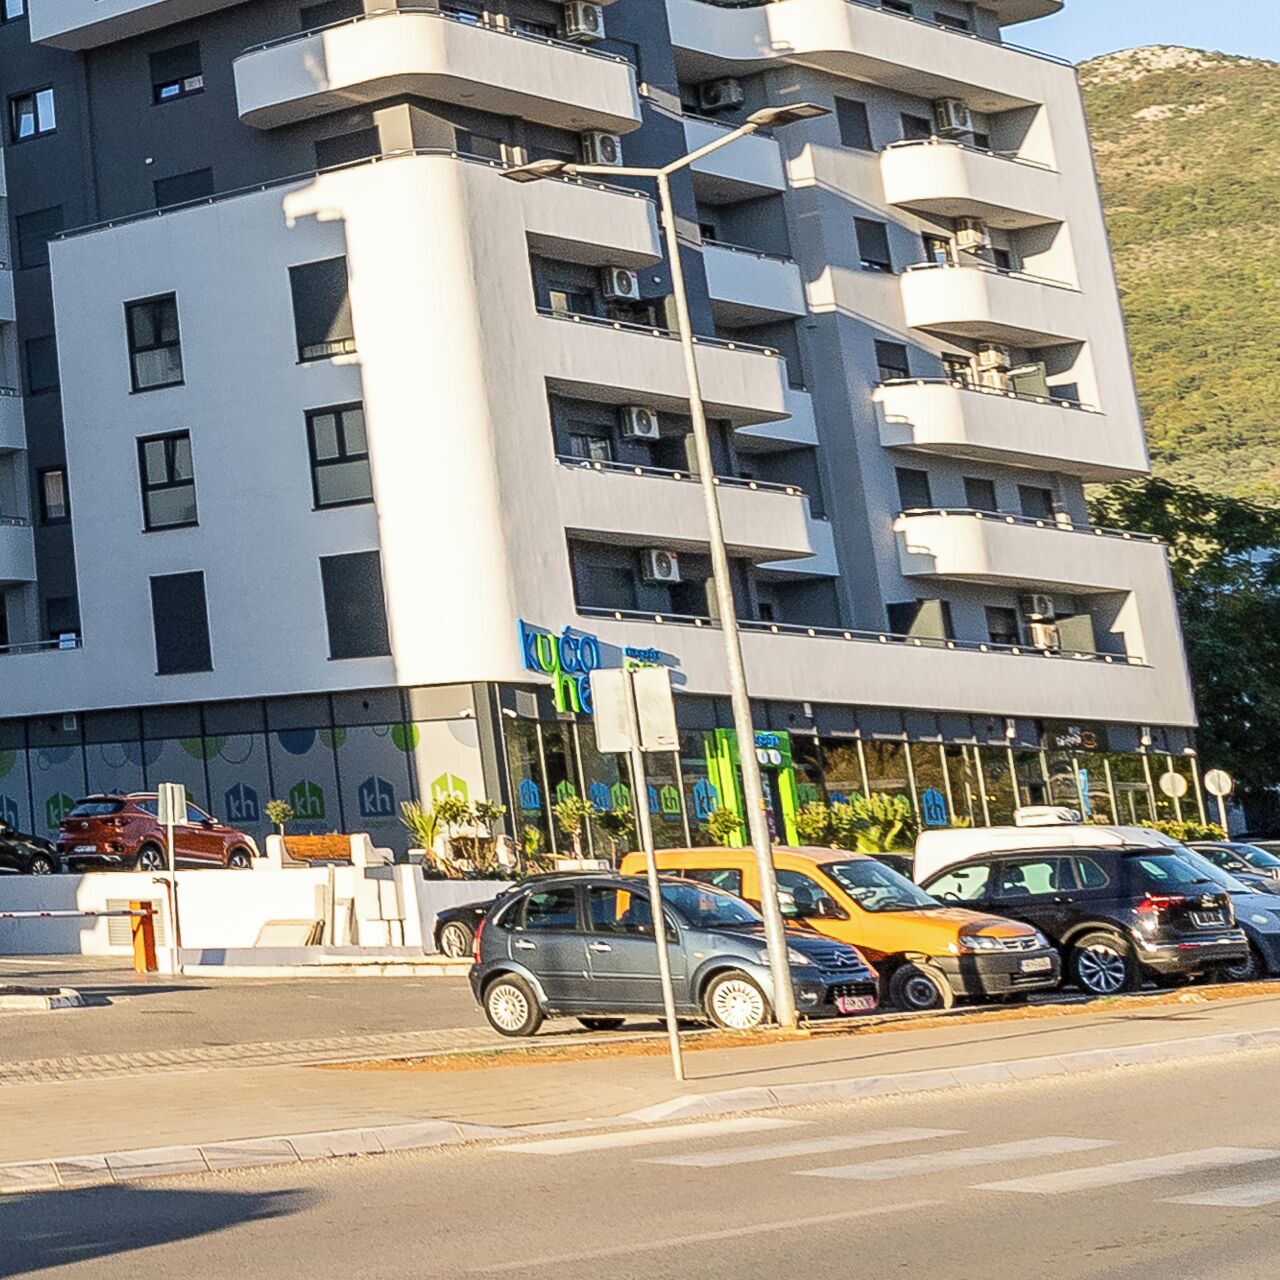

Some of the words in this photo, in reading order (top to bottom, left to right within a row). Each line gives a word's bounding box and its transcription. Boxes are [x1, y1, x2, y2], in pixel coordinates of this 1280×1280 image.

[229, 784, 256, 818] kh
[294, 780, 321, 815] kh
[363, 776, 390, 814] kh
